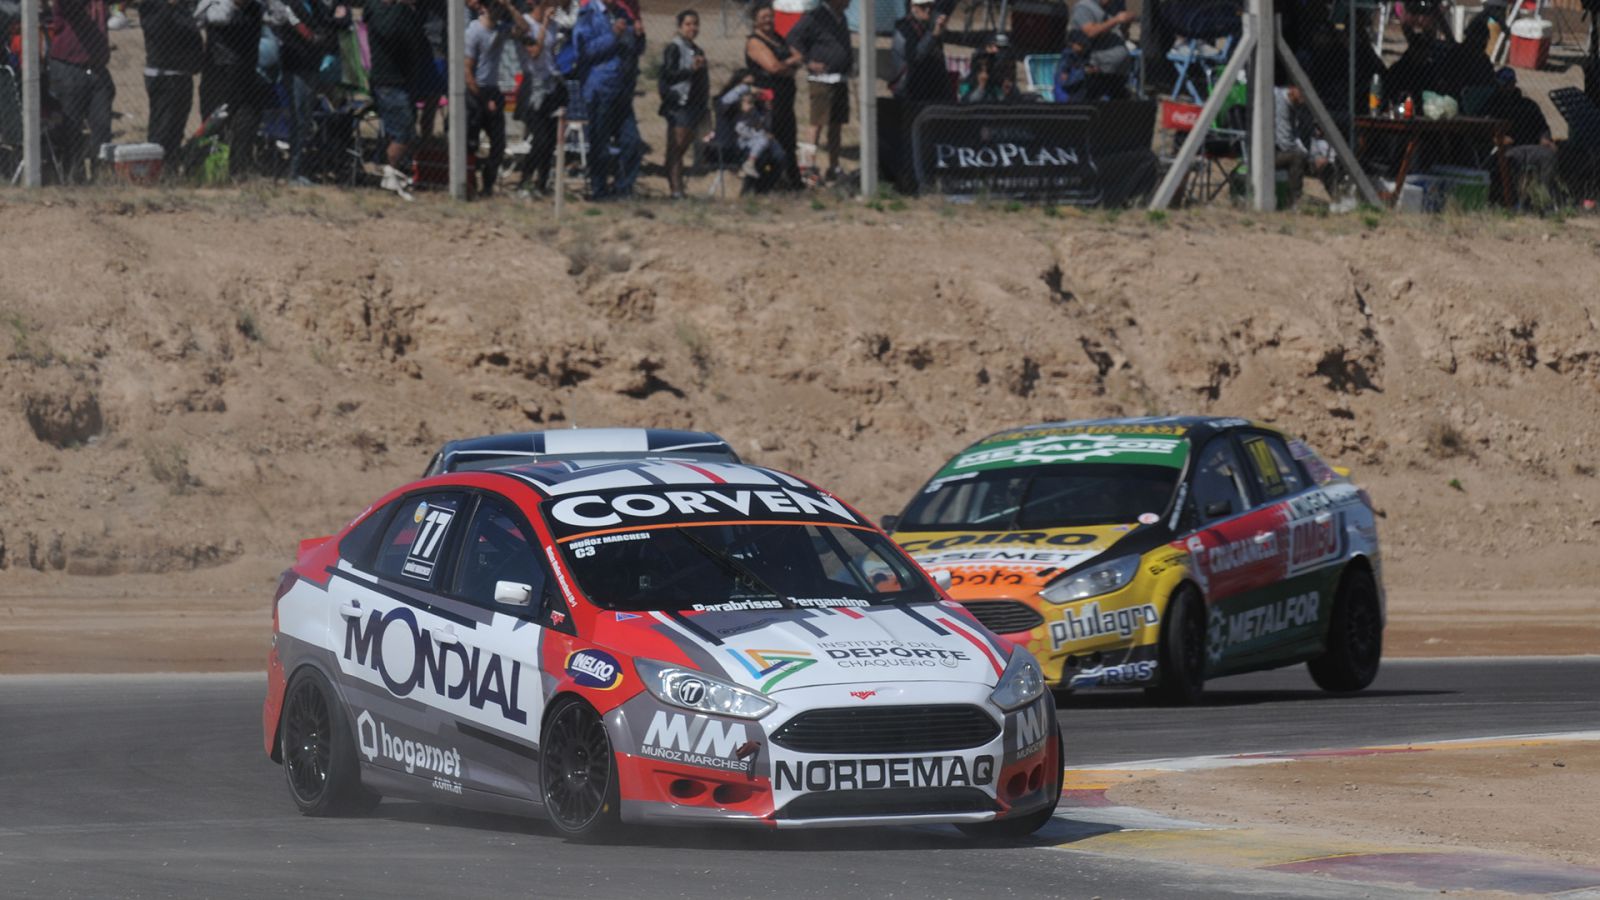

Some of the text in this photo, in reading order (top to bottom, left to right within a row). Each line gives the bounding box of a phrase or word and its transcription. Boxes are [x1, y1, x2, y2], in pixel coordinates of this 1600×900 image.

[956, 440, 1177, 467] METALFOR
[551, 488, 858, 527] CORVEN
[412, 510, 452, 558] 17
[569, 532, 651, 550] MUÑOZ MARCHESI
[575, 546, 596, 558] C3
[950, 570, 1024, 586] bota
[692, 599, 784, 613] Parabrisas
[787, 596, 871, 610] Pergamino
[1049, 603, 1159, 651] philagro
[1228, 591, 1320, 646] METALFOR
[817, 640, 944, 649] INSTITUTO DEL
[825, 646, 971, 661] DEPORTE
[343, 599, 527, 726] MONDIAL
[571, 652, 615, 678] INELRO
[1104, 661, 1153, 681] RUS
[682, 682, 701, 701] 17
[381, 721, 461, 778] hogarnet
[641, 745, 682, 761] MUÑOZ
[774, 754, 994, 792] NORDEMAQ
